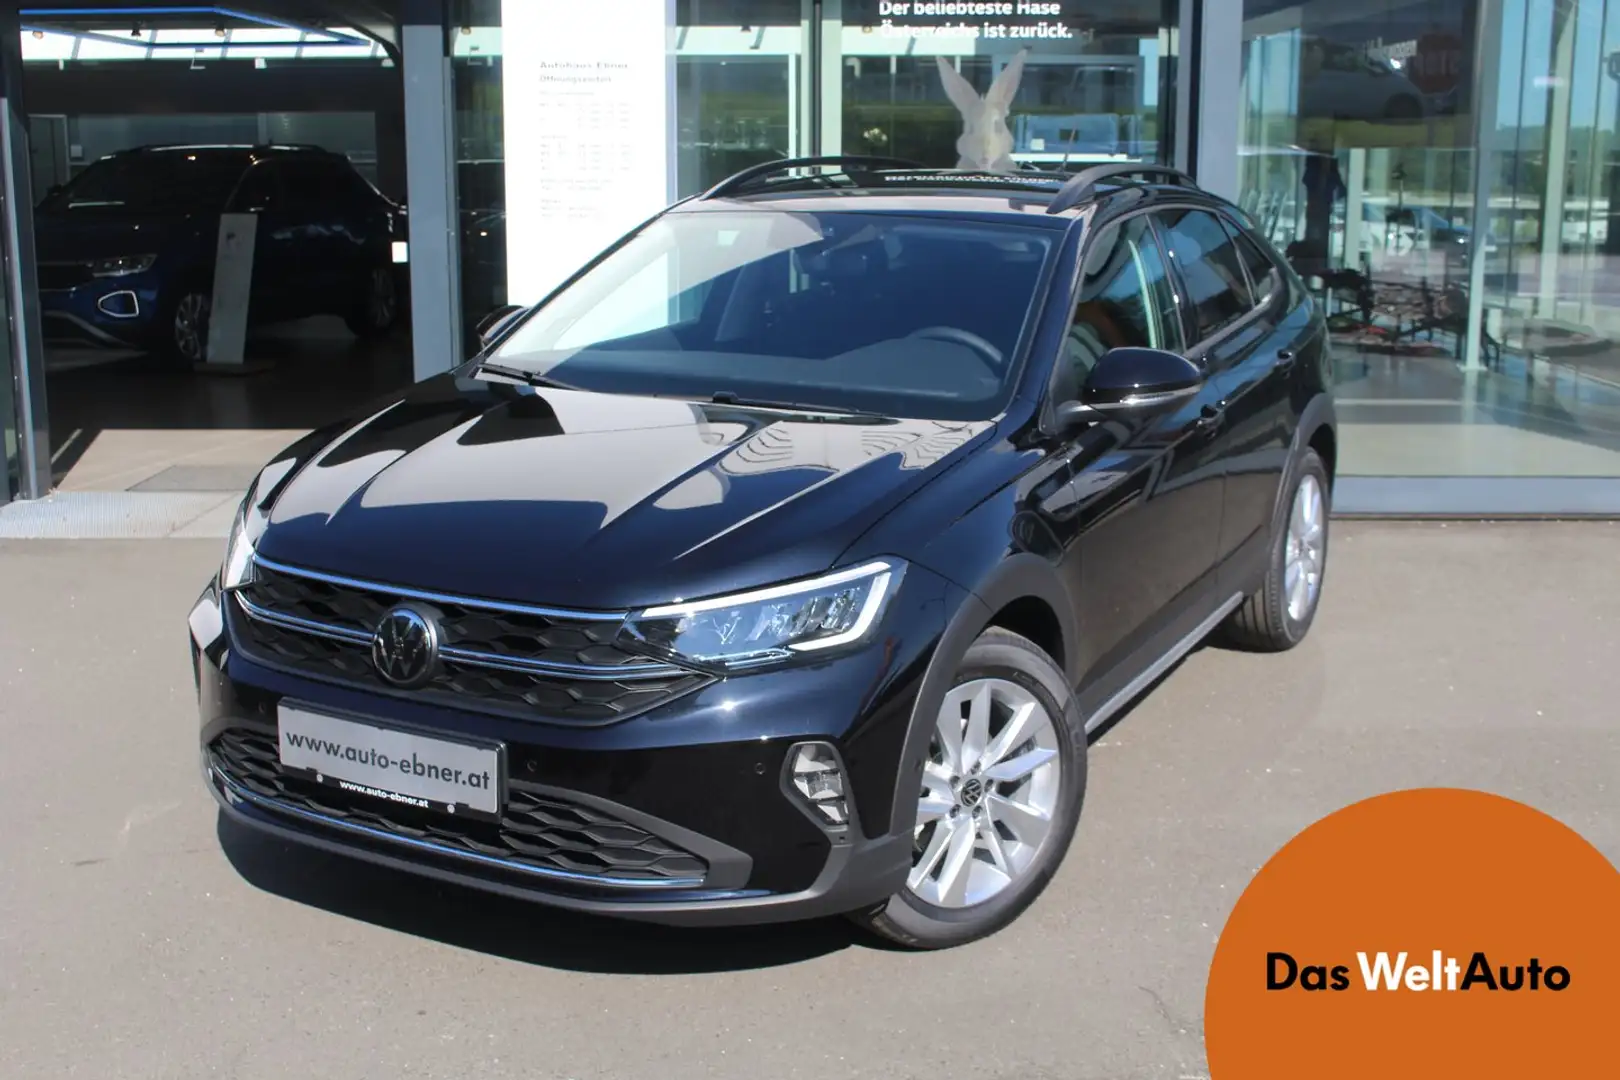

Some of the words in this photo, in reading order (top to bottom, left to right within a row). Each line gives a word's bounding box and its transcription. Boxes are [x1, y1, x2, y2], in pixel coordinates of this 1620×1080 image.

[879, 1, 911, 16] Der
[913, 0, 1013, 16] beliebteste
[1017, 0, 1061, 16] Hase
[983, 21, 1006, 39] ist
[1009, 21, 1073, 39] zurück.
[285, 730, 490, 790] www.auto-ebner.at
[339, 780, 429, 809] www.auto-ebner.at
